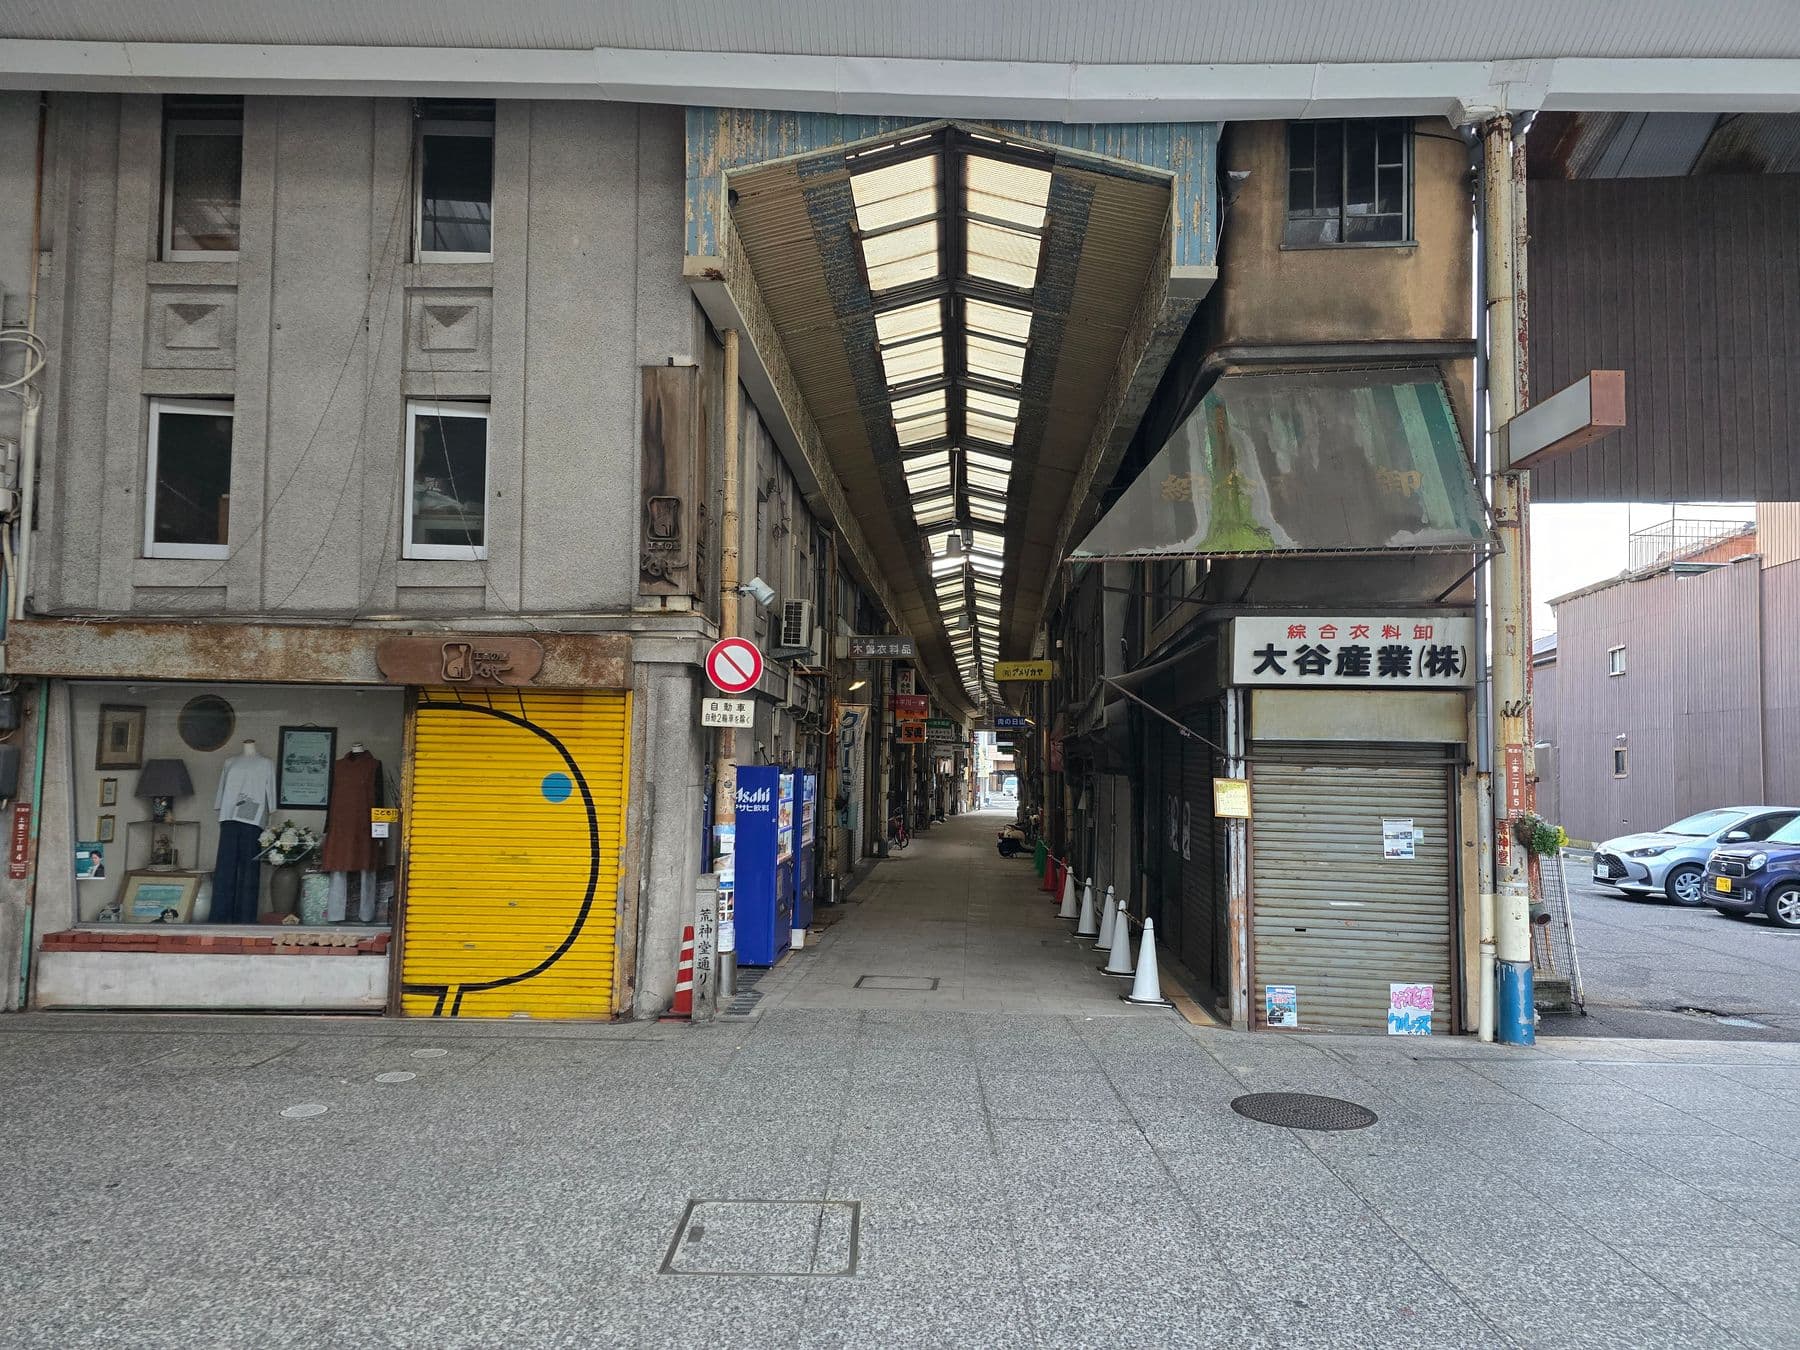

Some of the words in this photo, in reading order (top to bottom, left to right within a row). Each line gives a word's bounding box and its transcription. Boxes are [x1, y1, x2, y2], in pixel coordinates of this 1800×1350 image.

[1286, 623, 1434, 641] 綜合衣料卸
[1253, 642, 1467, 678] 大谷産業(株)
[710, 702, 746, 713] 自動車
[705, 712, 751, 724] 自動2輪車を除く
[736, 787, 770, 803] Asahi
[697, 908, 714, 987] 荒神堂通り
